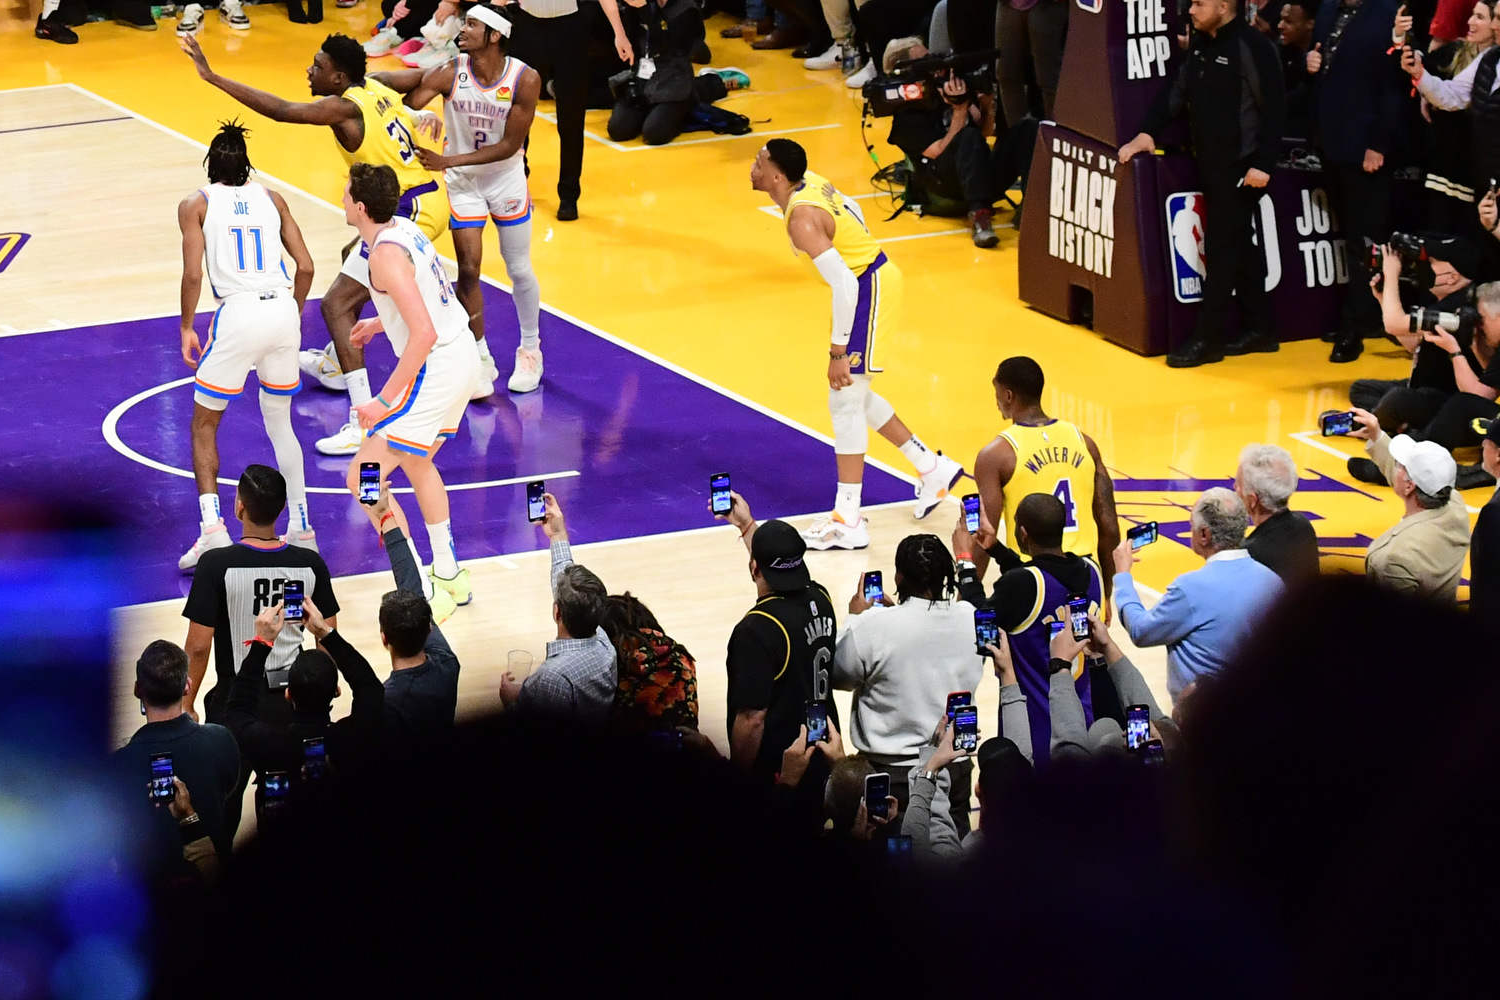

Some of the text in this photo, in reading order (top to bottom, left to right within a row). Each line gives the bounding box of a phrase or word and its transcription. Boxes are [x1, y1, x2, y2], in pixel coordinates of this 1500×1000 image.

[1126, 35, 1171, 81] APP
[386, 116, 417, 165] 31
[467, 115, 494, 130] CITY
[474, 130, 487, 152] 2
[1052, 137, 1118, 174] BUILT BY
[233, 200, 250, 216] JOE
[1049, 156, 1118, 241] BLACK
[228, 225, 267, 274] 11
[1048, 214, 1114, 279] HISTORY
[1025, 447, 1086, 476] WALKER IV
[1052, 478, 1079, 533] 4
[804, 616, 833, 646] JAMES
[813, 646, 831, 701] 6
